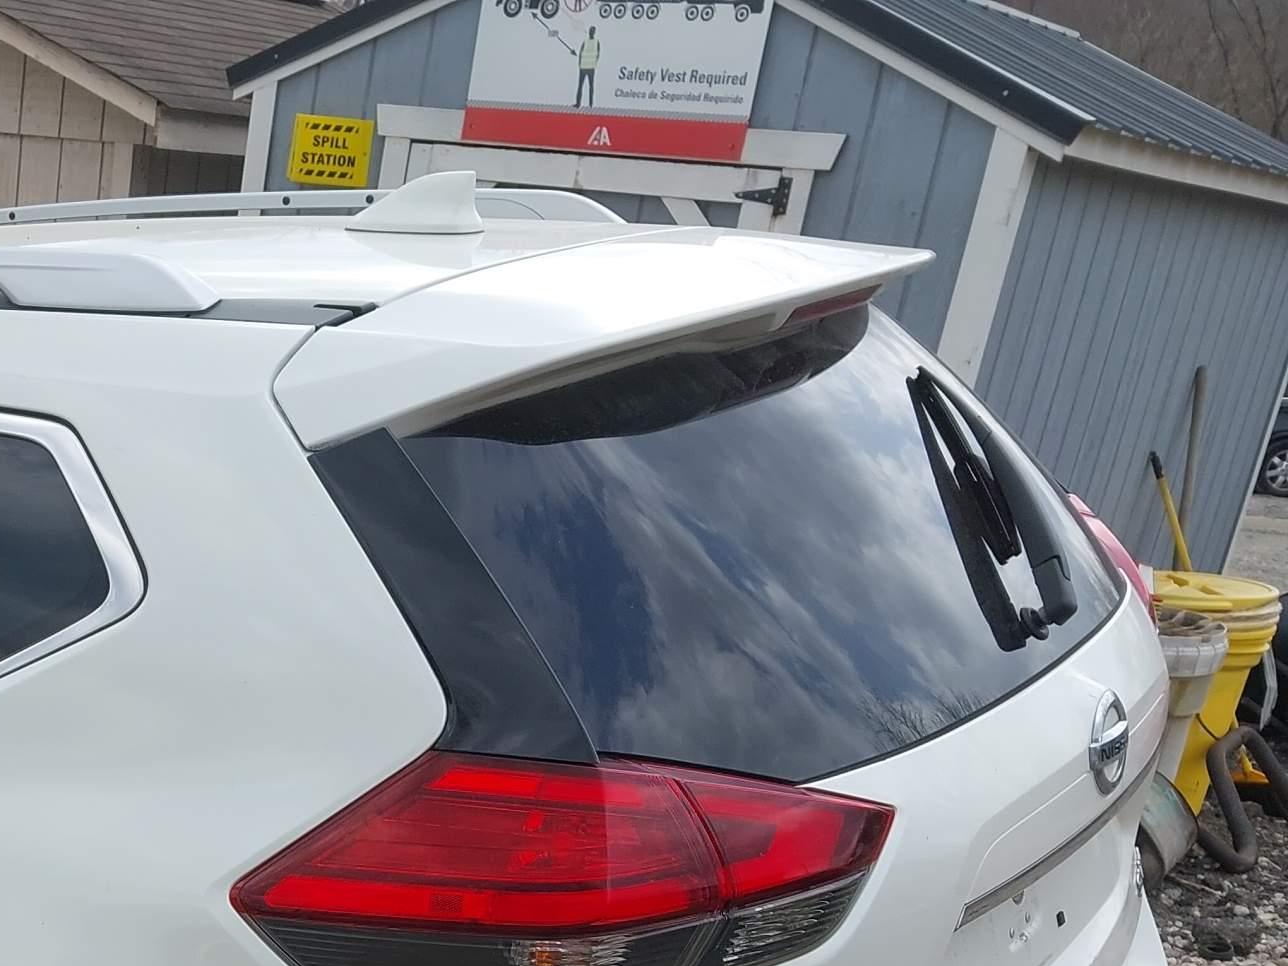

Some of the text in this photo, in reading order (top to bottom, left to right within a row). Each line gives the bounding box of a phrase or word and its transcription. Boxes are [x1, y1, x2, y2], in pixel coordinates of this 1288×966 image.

[618, 66, 748, 88] Safety Vest Required
[647, 90, 658, 100] de
[659, 90, 702, 103] Seguridad
[312, 135, 349, 150] SPILL
[300, 151, 357, 168] STATION
